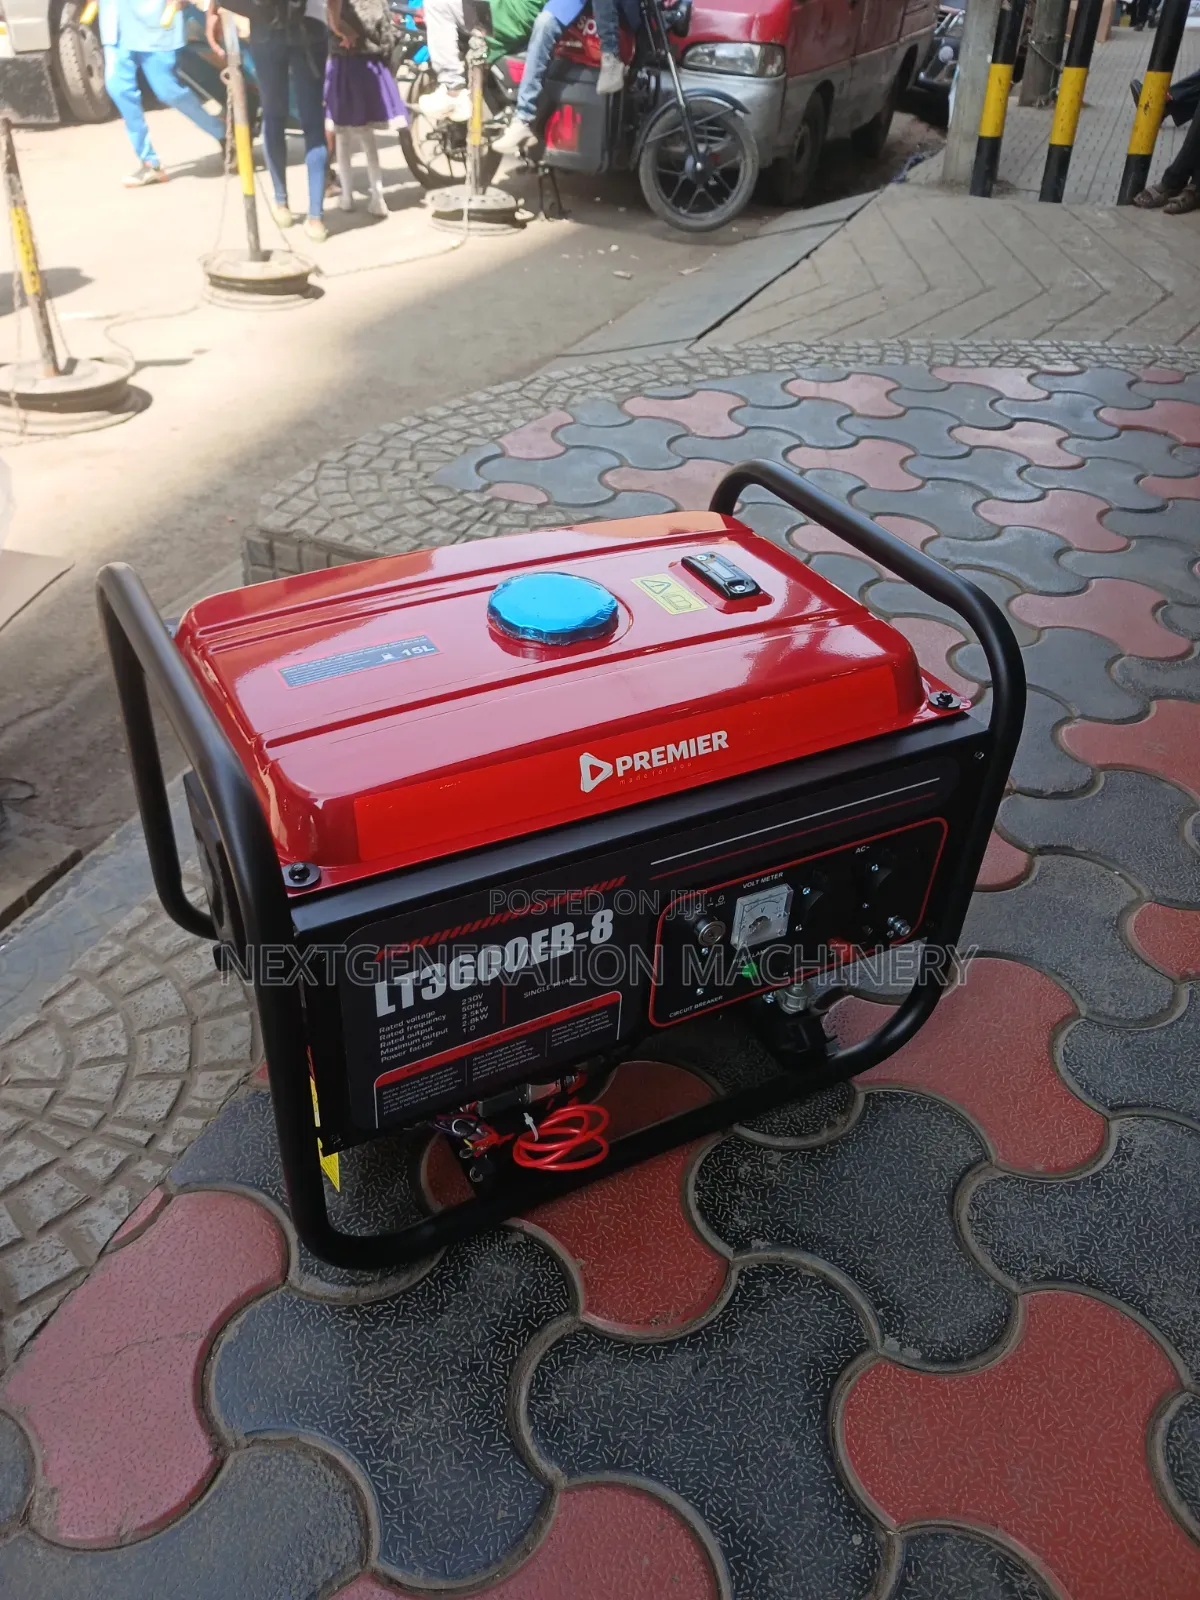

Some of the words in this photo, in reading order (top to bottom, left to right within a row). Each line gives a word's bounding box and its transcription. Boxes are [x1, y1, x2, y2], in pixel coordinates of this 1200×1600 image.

[402, 645, 435, 657] 15L
[615, 730, 729, 777] PREMIER
[620, 774, 648, 785] made
[652, 767, 669, 777] for
[672, 762, 692, 773] you
[742, 879, 759, 889] VOLT
[761, 872, 784, 883] METER
[374, 908, 614, 1018] LT3600EB-8
[524, 985, 550, 998] SINGLE
[379, 1020, 404, 1034] Rated
[406, 1010, 436, 1024] voltage
[461, 993, 484, 1006] 230V
[669, 1005, 694, 1018] CIRCUIT
[694, 995, 723, 1009] BREAKER
[379, 1028, 404, 1041] Rated
[407, 1014, 447, 1034] frequency
[380, 1036, 405, 1049] Rated
[407, 1026, 434, 1039] output
[462, 1006, 489, 1020] 2.5kW
[380, 1039, 421, 1056] Maximum
[422, 1028, 448, 1041] output
[381, 1050, 407, 1063] Power
[409, 1040, 434, 1053] factor
[462, 1025, 476, 1034] 1.0
